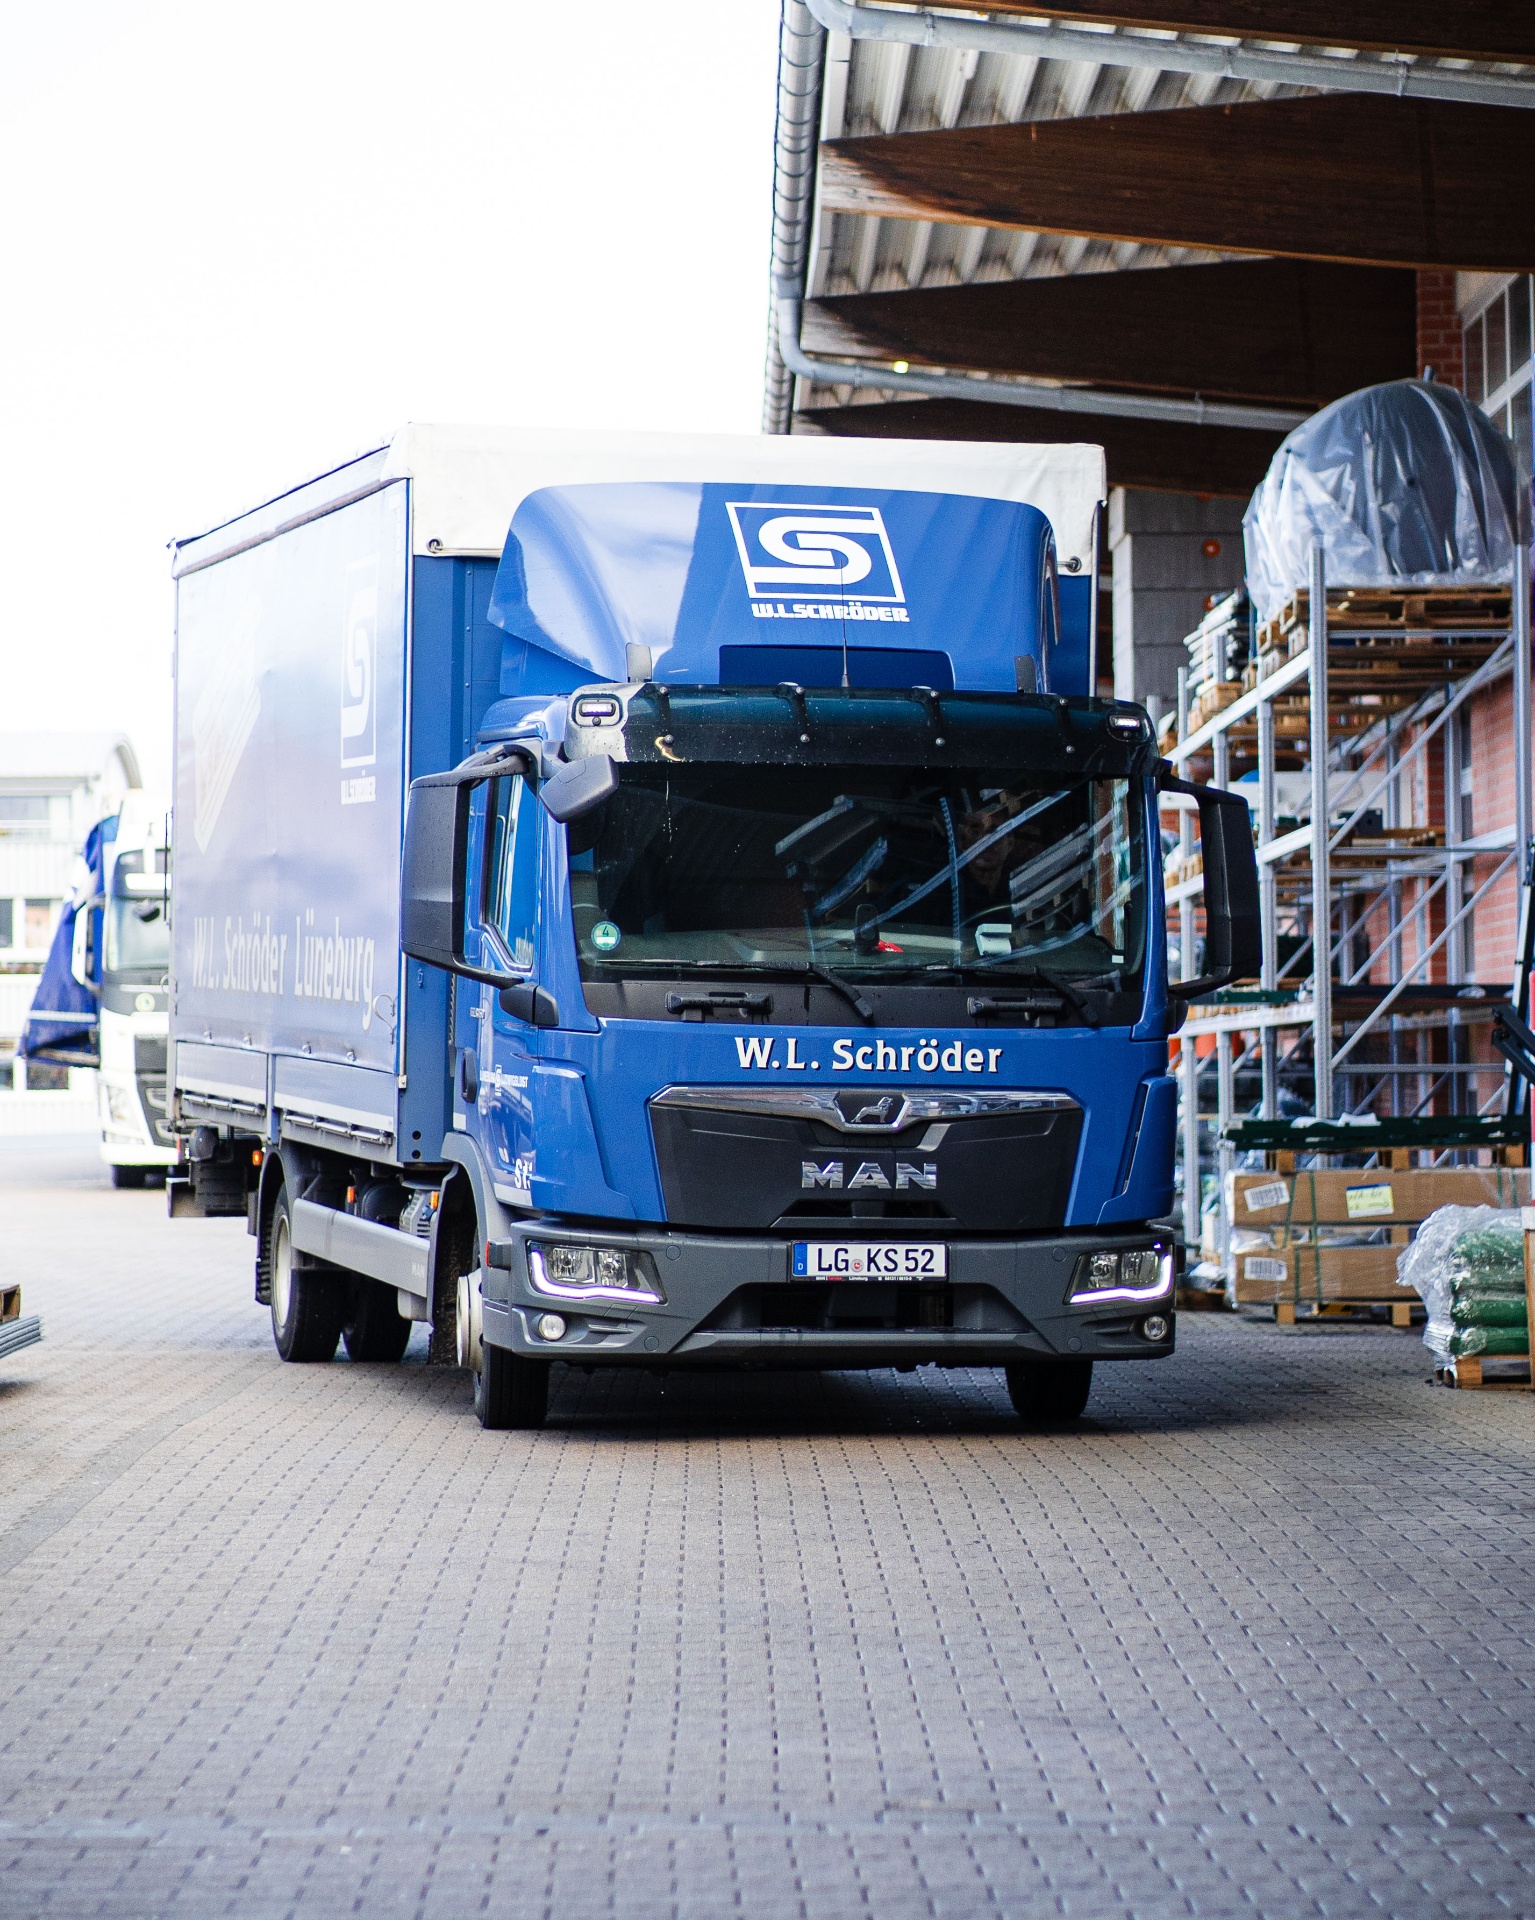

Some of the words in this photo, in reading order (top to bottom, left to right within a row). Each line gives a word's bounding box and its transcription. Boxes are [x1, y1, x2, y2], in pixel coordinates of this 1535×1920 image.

[602, 925, 609, 937] 4
[223, 911, 288, 995] Schröder
[294, 907, 375, 1031] Lüneburg
[734, 1037, 819, 1070] W.L.
[832, 1038, 1002, 1073] Schröder
[801, 1161, 937, 1190] MAN
[797, 1262, 804, 1271] D
[817, 1248, 849, 1272] LG
